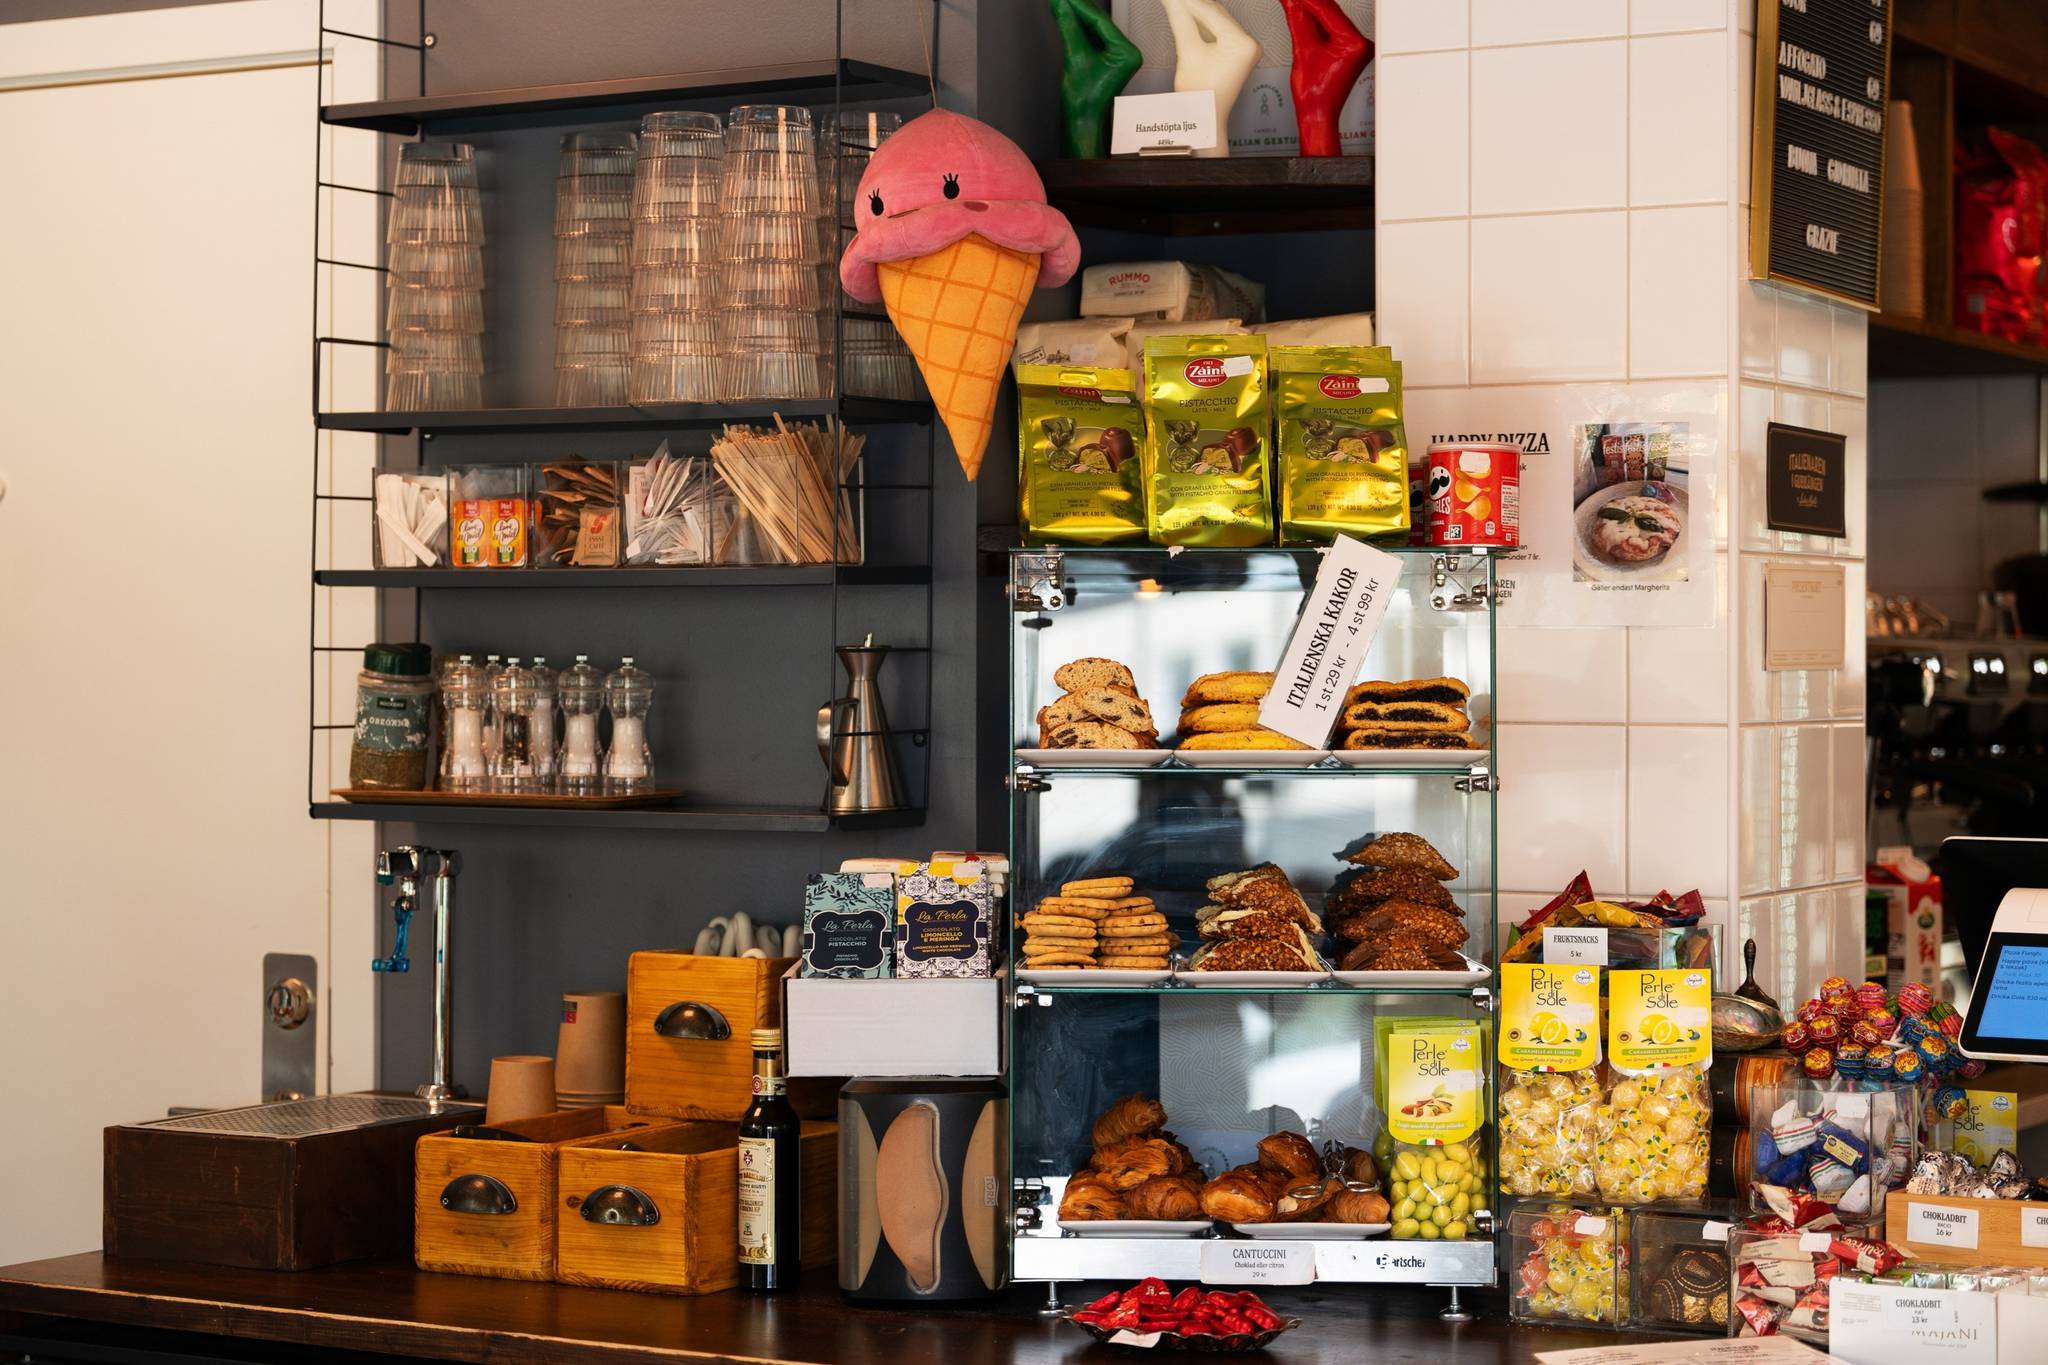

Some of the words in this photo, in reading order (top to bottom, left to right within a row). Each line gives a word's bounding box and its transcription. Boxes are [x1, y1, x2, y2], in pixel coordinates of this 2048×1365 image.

[1779, 41, 1826, 80] AFFOGATO
[1867, 77, 1880, 100] 69
[1136, 122, 1181, 133] Handstöpta
[1183, 121, 1197, 132] ljus
[1264, 136, 1298, 145] GESTU
[1806, 223, 1839, 254] GRAZIE
[1108, 272, 1151, 287] RUMMO
[1179, 396, 1239, 408] PISTACCHIO
[1313, 407, 1374, 416] PISTACCHIO
[1365, 577, 1379, 593] kr
[1635, 584, 1670, 592] Margherita
[1358, 592, 1372, 611] 99
[1354, 612, 1365, 626] st
[1286, 622, 1334, 709] ITALIENSKA
[1324, 568, 1357, 620] KAKOR
[1348, 626, 1359, 636] 4
[1332, 654, 1346, 670] kr
[1326, 669, 1340, 687] 29
[1322, 686, 1333, 702] st
[1316, 703, 1327, 712] 1
[915, 911, 933, 924] La
[935, 909, 969, 920] Perla
[821, 920, 840, 932] La
[842, 920, 875, 930] Perla
[1553, 935, 1599, 944] FRUKTSNACKS
[1531, 968, 1563, 992] Perle
[1641, 973, 1674, 996] Perle
[1536, 990, 1568, 1006] Sole
[1646, 993, 1679, 1008] Sole
[1413, 1038, 1446, 1064] Perle
[1418, 1060, 1450, 1076] Sole
[1922, 1211, 1967, 1224] CHOKLADBIT
[2036, 1216, 2048, 1225] CHO
[1232, 1248, 1286, 1259] CANTUCCINI
[1896, 1298, 1942, 1309] CHOKLADBIT
